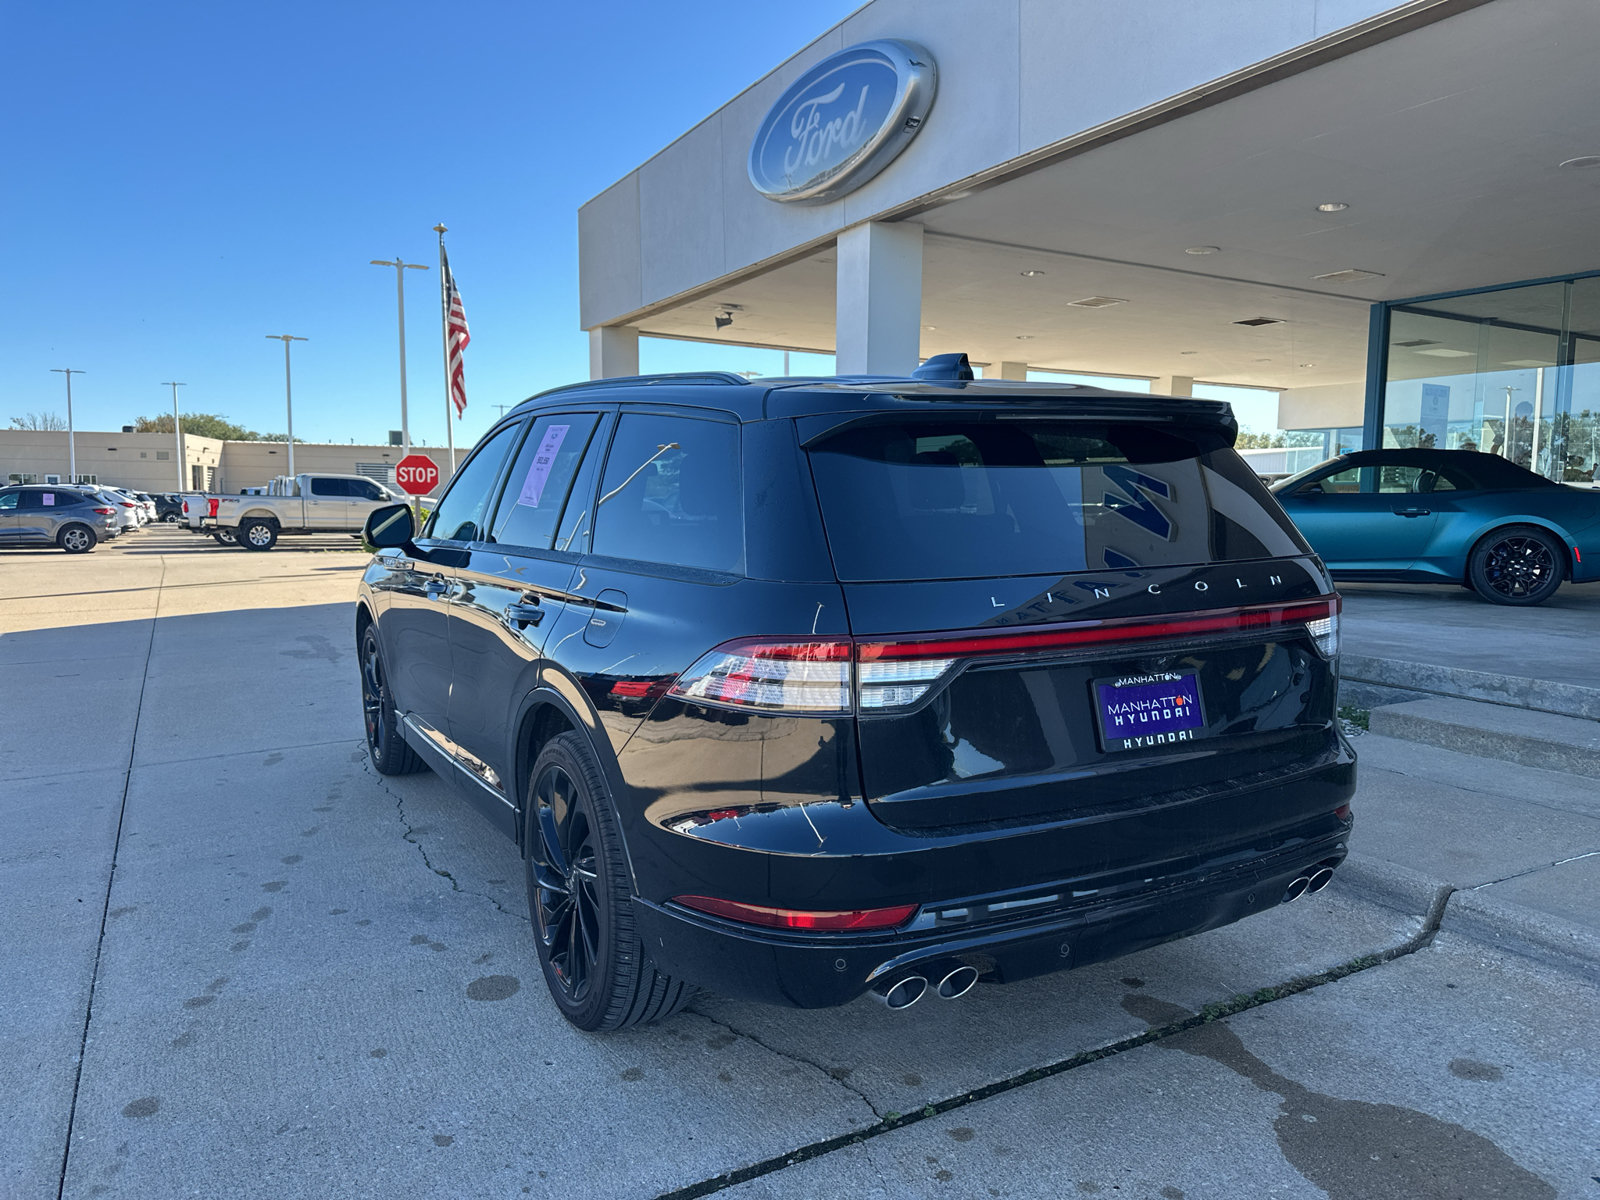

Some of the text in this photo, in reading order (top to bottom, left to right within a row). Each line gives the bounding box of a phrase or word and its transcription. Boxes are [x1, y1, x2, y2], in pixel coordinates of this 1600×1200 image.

[784, 82, 870, 176] Ford
[398, 467, 437, 483] STOP
[990, 574, 1282, 608] LINCOLN
[1118, 672, 1177, 686] MANHATTN
[1107, 694, 1193, 715] MANHATTN
[1114, 706, 1190, 726] HYUNDAI
[1123, 729, 1193, 749] HYUNDAI
